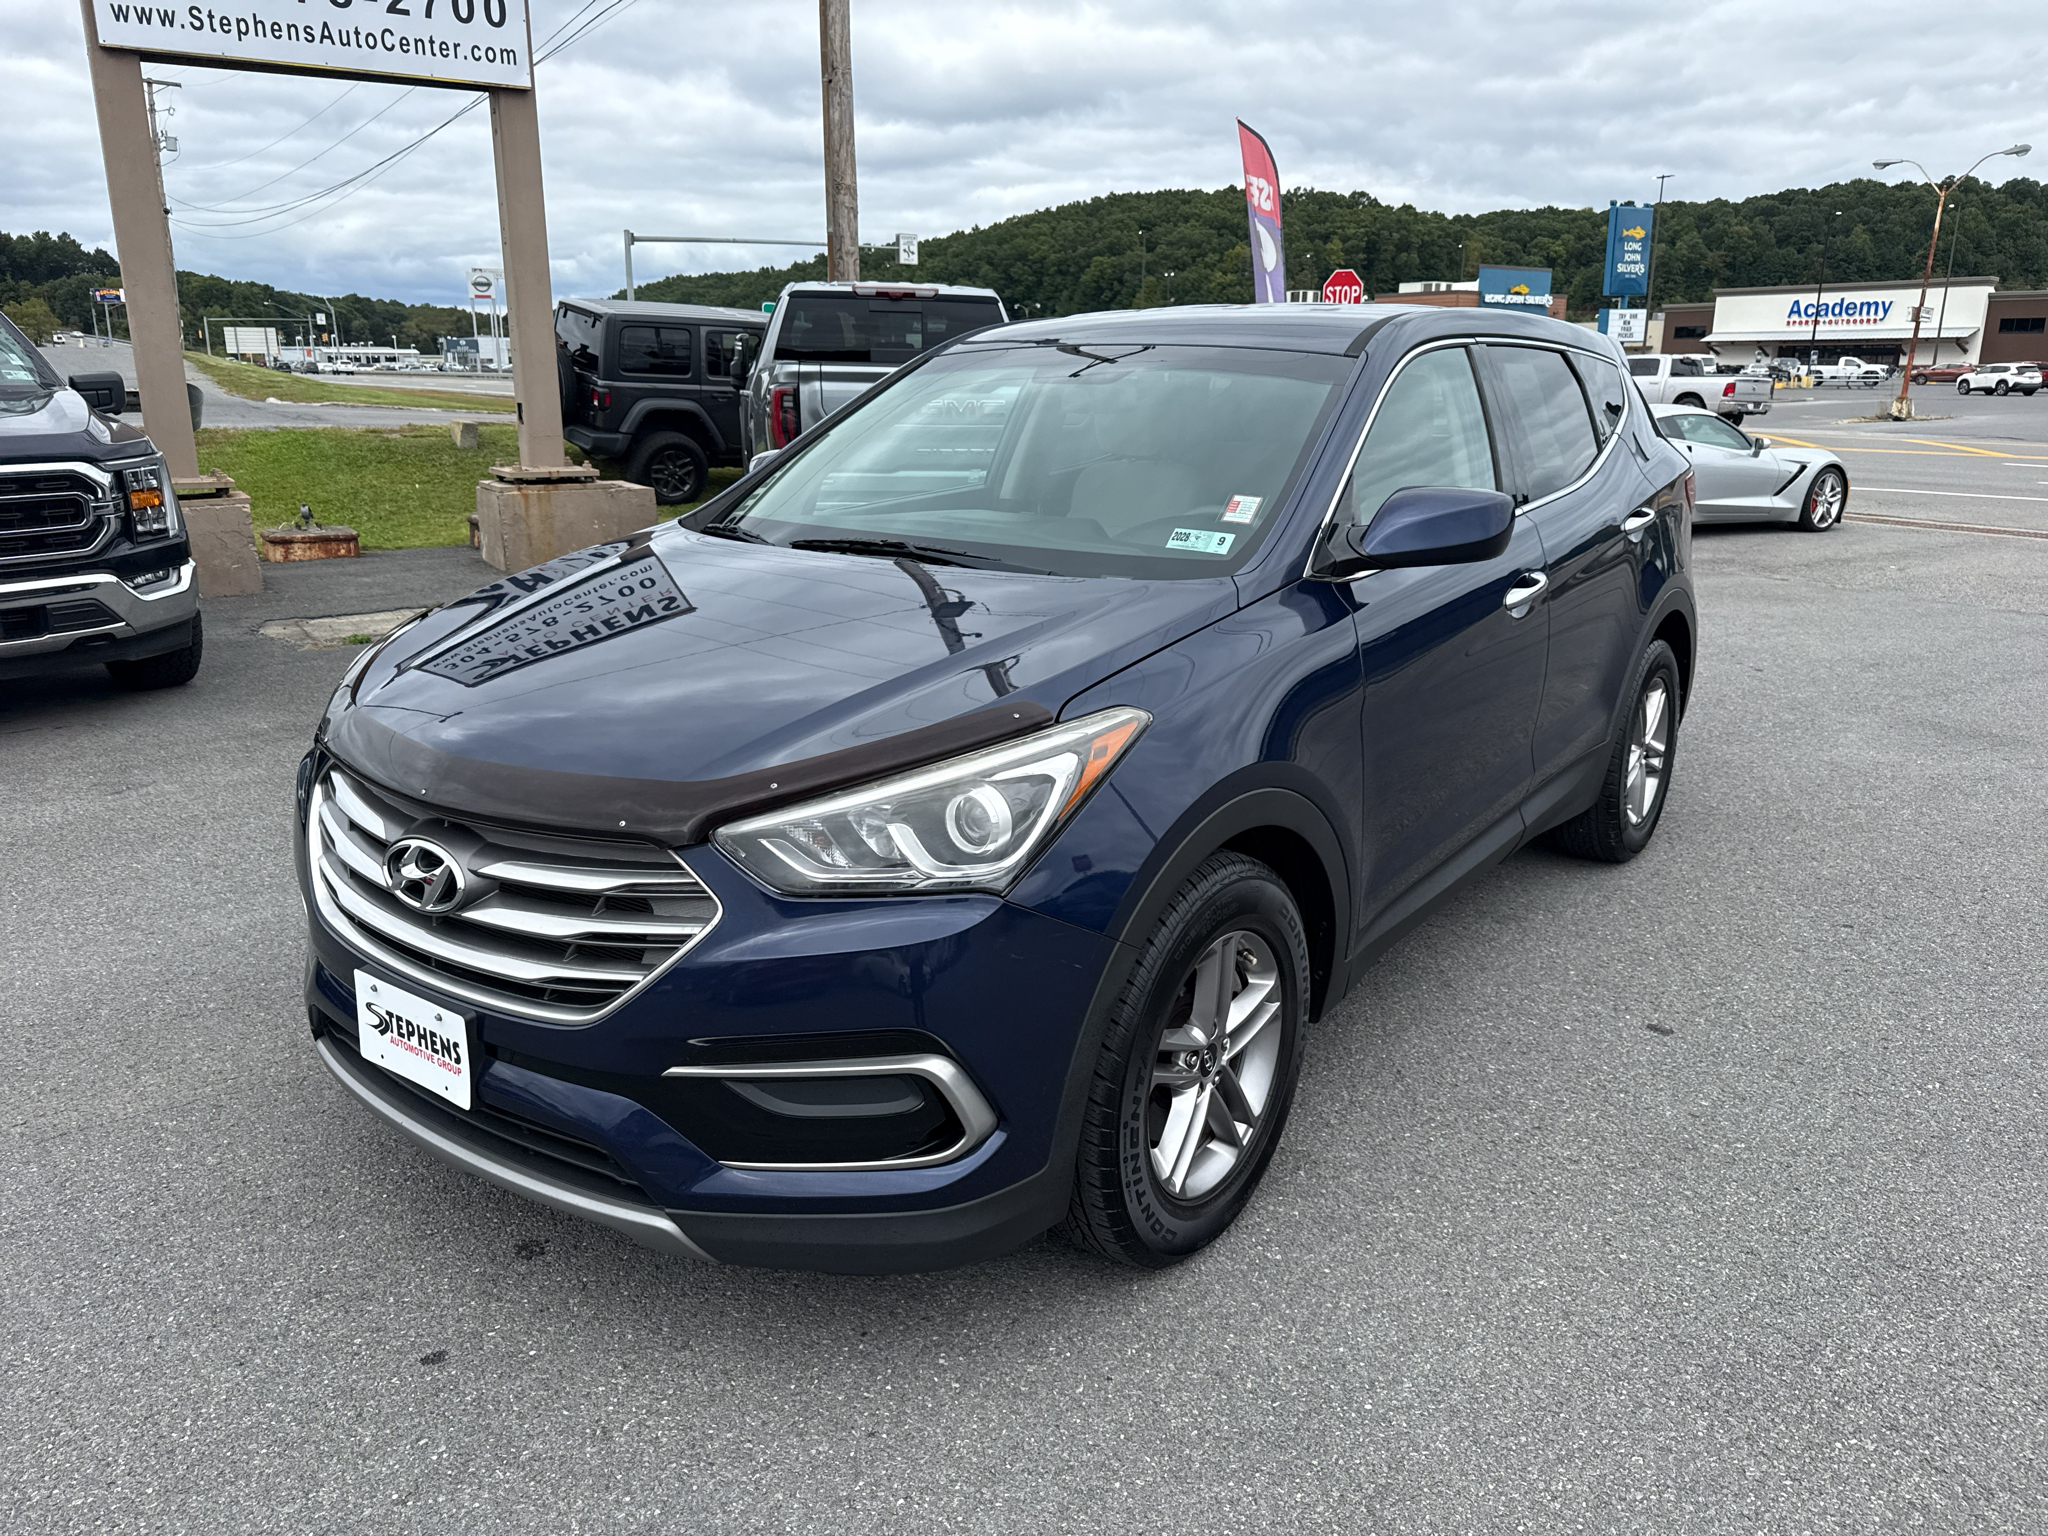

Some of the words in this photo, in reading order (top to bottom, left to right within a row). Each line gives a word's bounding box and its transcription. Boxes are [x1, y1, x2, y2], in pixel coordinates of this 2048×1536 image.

[110, 3, 517, 66] www.StephensAutoCenter.com
[1624, 241, 1642, 251] LONG
[1624, 253, 1641, 262] JOHN
[1617, 263, 1645, 276] SILVER'S
[1326, 285, 1360, 304] STOP
[1484, 294, 1505, 303] LONG
[1505, 294, 1524, 304] JOHN
[1787, 297, 1894, 321] Academy
[1217, 536, 1226, 546] 9
[366, 1002, 461, 1065] STEPHENS
[390, 1036, 435, 1064] AUTOMOTIVE
[437, 1058, 461, 1076] GROUP
